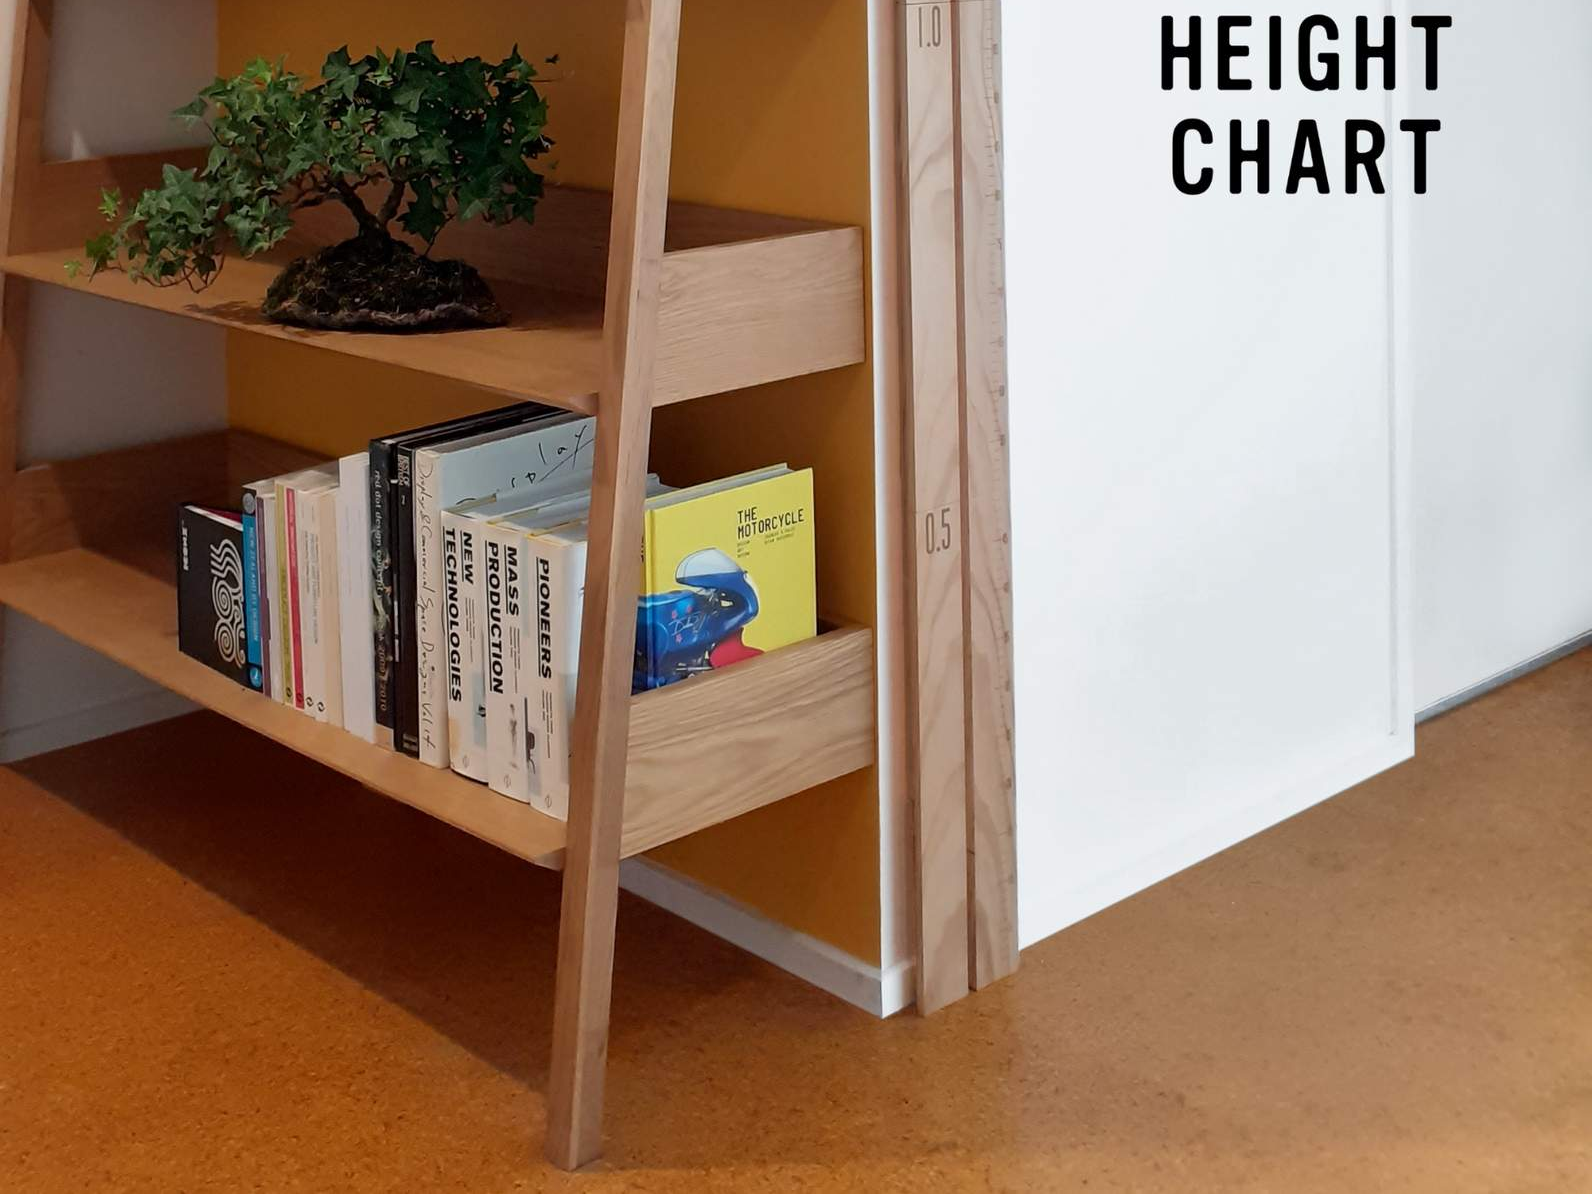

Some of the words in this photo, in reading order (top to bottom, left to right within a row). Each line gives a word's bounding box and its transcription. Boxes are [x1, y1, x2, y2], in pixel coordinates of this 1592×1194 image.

[918, 5, 940, 47] 1.0
[737, 506, 758, 523] THE
[737, 508, 804, 540] MOTORCYCLE
[925, 507, 950, 554] 0.5
[462, 531, 474, 585] NEW
[506, 545, 520, 617] MASS
[444, 527, 462, 702] TECHNOLOGIES
[487, 541, 504, 695] PRODUCTION
[537, 558, 552, 679] PIONEERS
